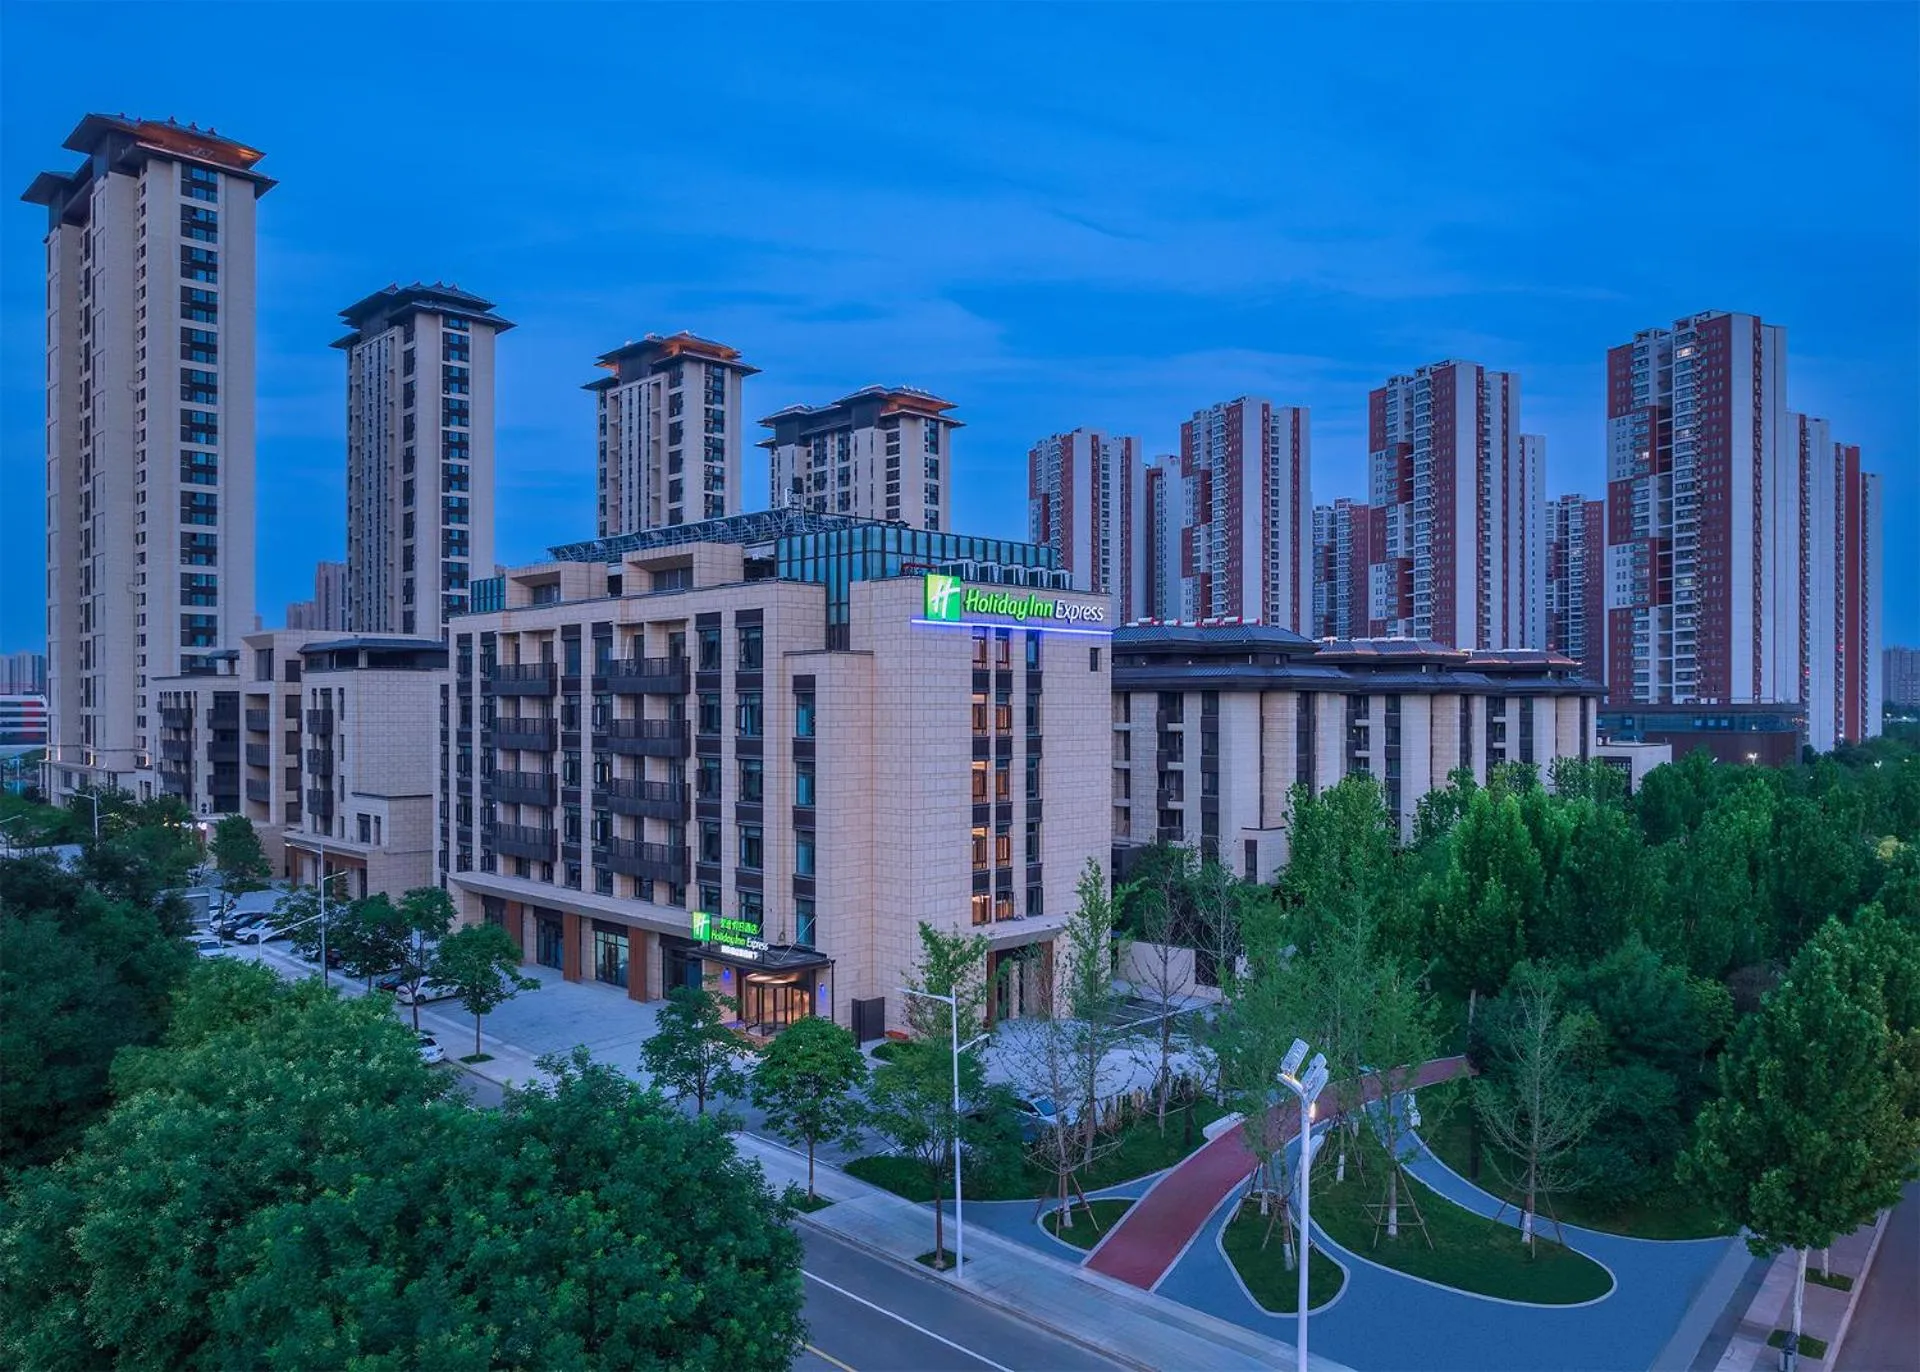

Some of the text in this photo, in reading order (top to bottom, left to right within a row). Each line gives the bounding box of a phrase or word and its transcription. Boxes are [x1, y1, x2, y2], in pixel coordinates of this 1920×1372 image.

[965, 588, 1104, 624] Holiday Inn Express
